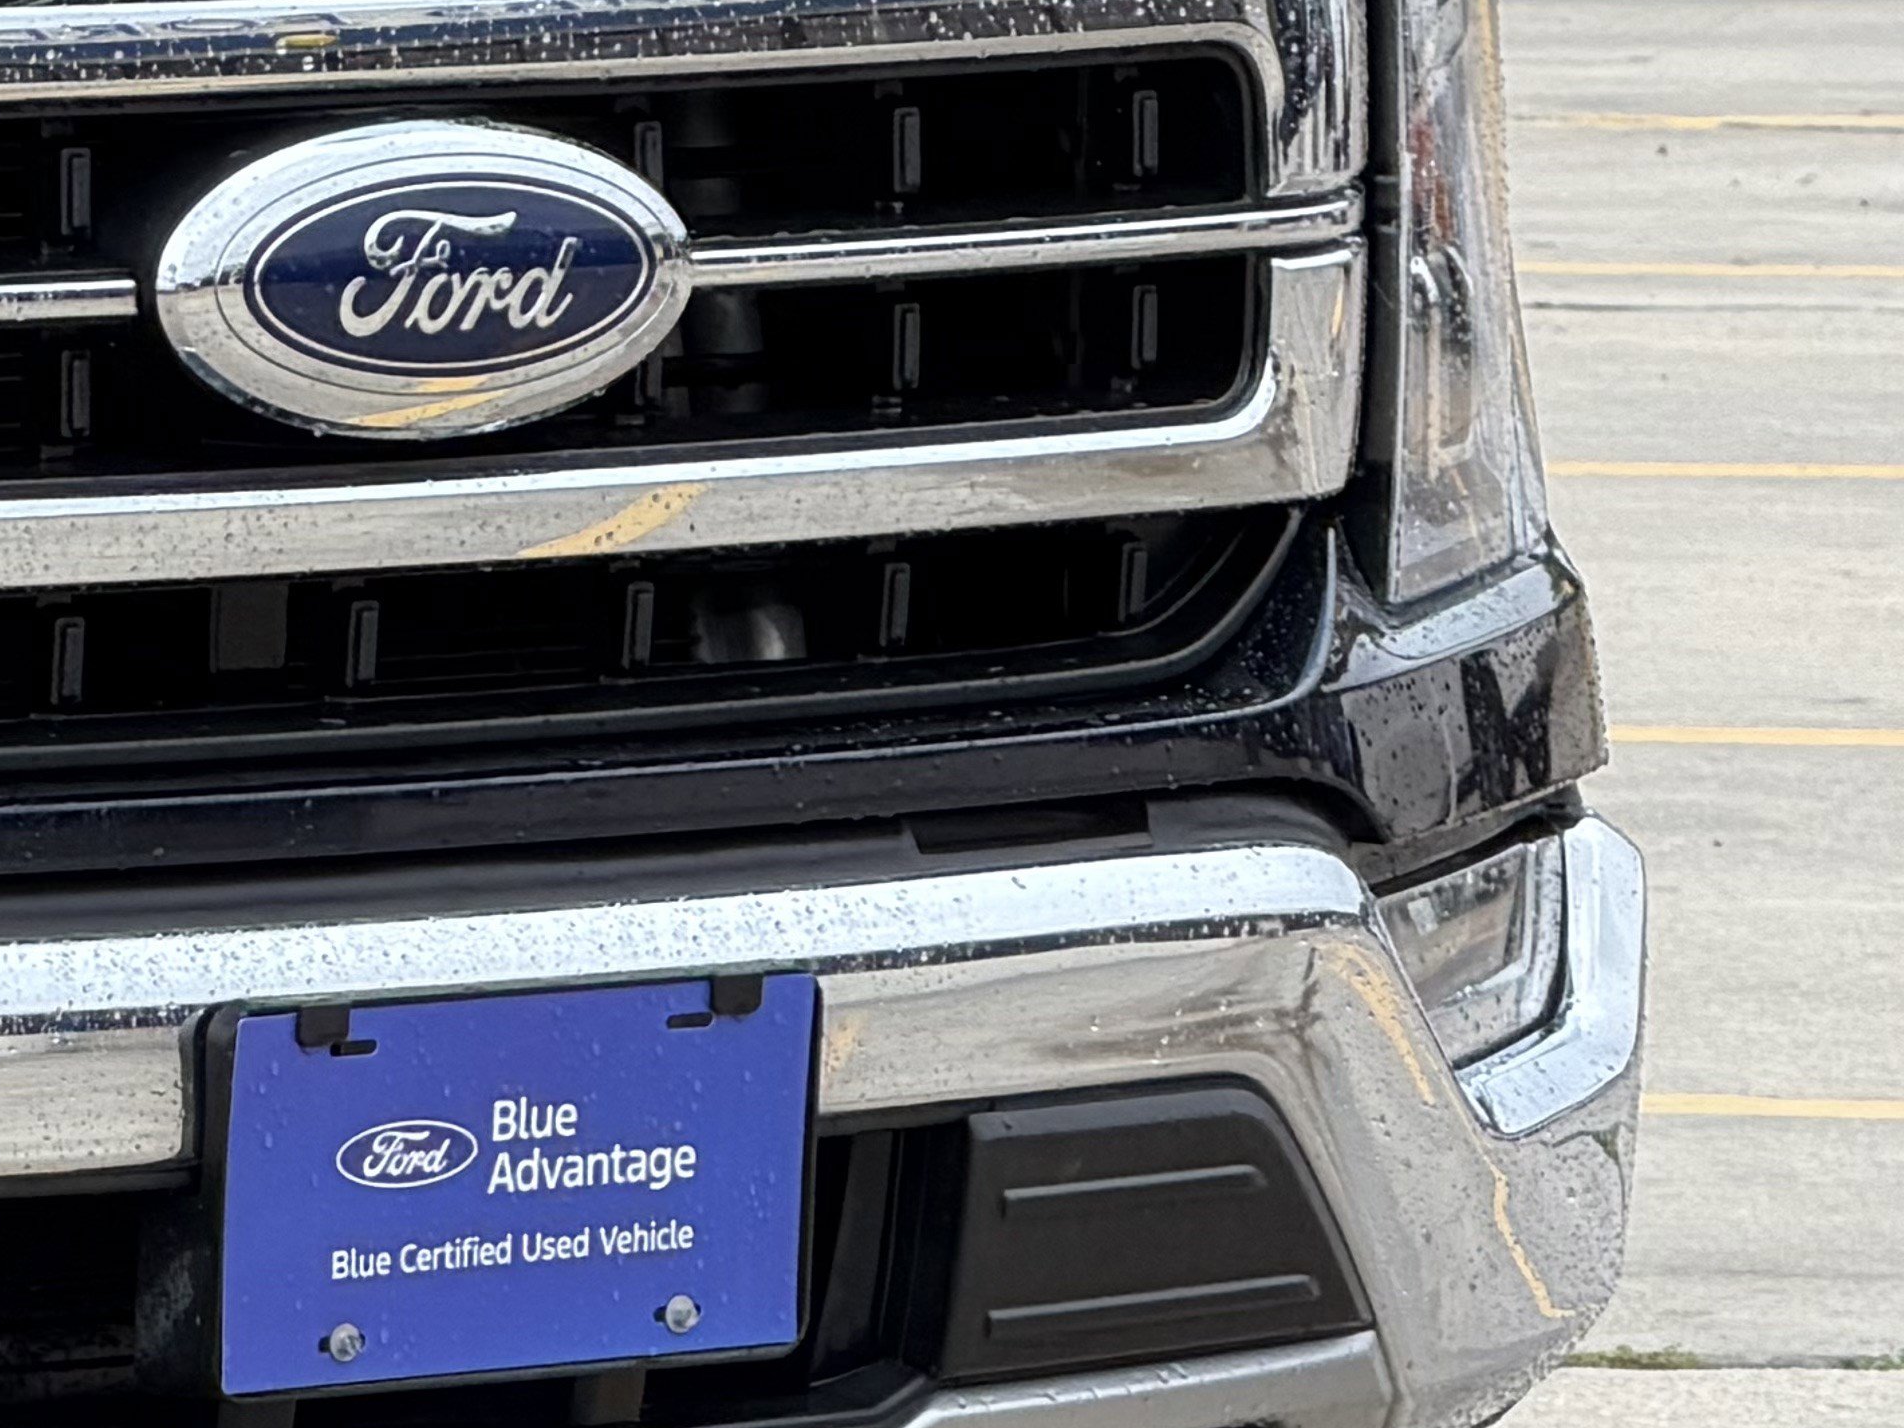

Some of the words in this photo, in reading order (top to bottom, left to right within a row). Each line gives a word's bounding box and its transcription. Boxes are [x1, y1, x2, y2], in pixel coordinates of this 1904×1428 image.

[338, 209, 582, 338] Ford
[491, 1096, 579, 1143] Blue
[362, 1130, 449, 1178] Ford
[487, 1140, 697, 1194] Advantage
[330, 1248, 391, 1280] Blue
[399, 1233, 512, 1274] Certified
[522, 1226, 589, 1263] Used
[600, 1219, 694, 1255] Vehicle
